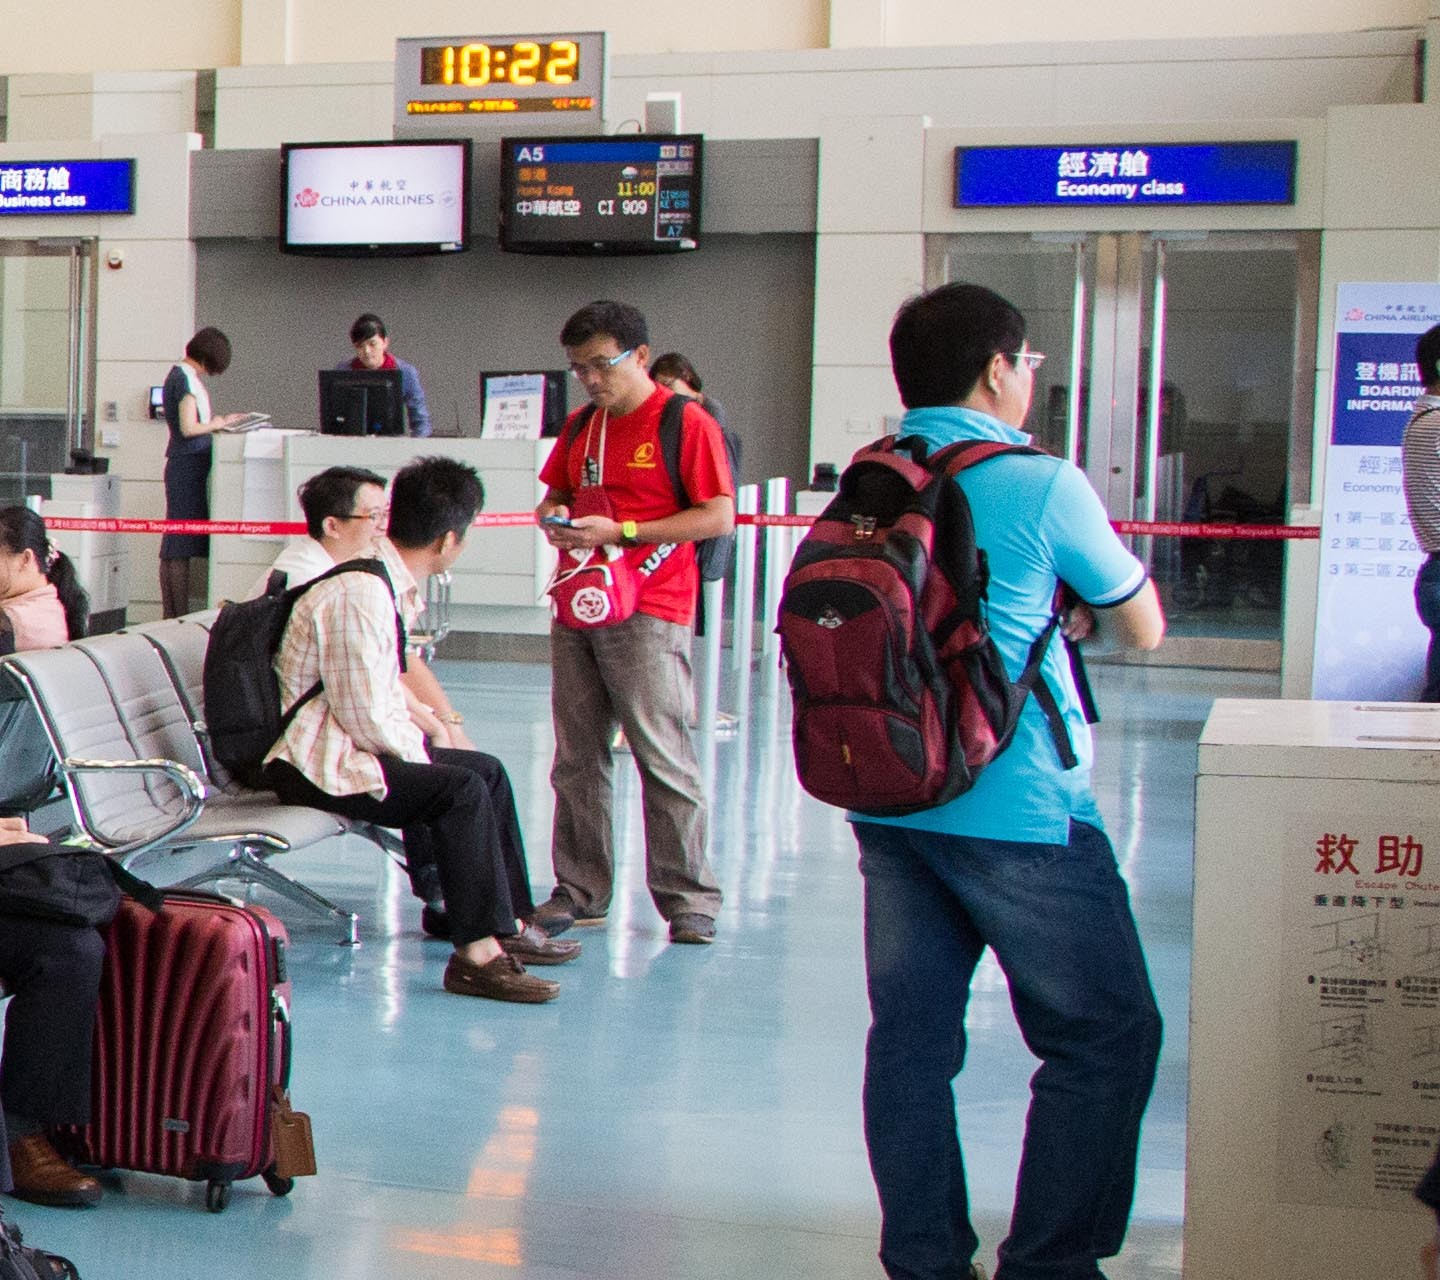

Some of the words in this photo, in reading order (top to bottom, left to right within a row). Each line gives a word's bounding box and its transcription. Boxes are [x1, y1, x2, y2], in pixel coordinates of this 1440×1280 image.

[443, 40, 578, 88] 10:22
[517, 145, 545, 162] A5
[1057, 151, 1149, 178] 經濟艙
[350, 179, 408, 191] 中華航空
[617, 182, 656, 197] 11:00
[1056, 180, 1137, 199] Economy
[1141, 178, 1184, 196] class
[53, 192, 86, 207] class
[321, 195, 367, 207] CHINA
[371, 193, 434, 206] AIRLINES
[516, 199, 582, 216] 中華航空
[598, 200, 615, 216] CI
[622, 199, 648, 215] 909
[1364, 313, 1397, 321] CHINA
[1360, 385, 1427, 397] BOARDIN
[1347, 399, 1417, 412] INFORMA
[1343, 481, 1401, 495] Economy
[118, 520, 147, 531] Taiwan
[149, 521, 184, 533] Taoyuan
[185, 522, 239, 533] International
[239, 523, 272, 535] Airport
[1236, 527, 1275, 538] Taoyuan
[1314, 832, 1423, 877] 救助
[1354, 880, 1399, 890] Escape
[1404, 881, 1440, 891] Chute
